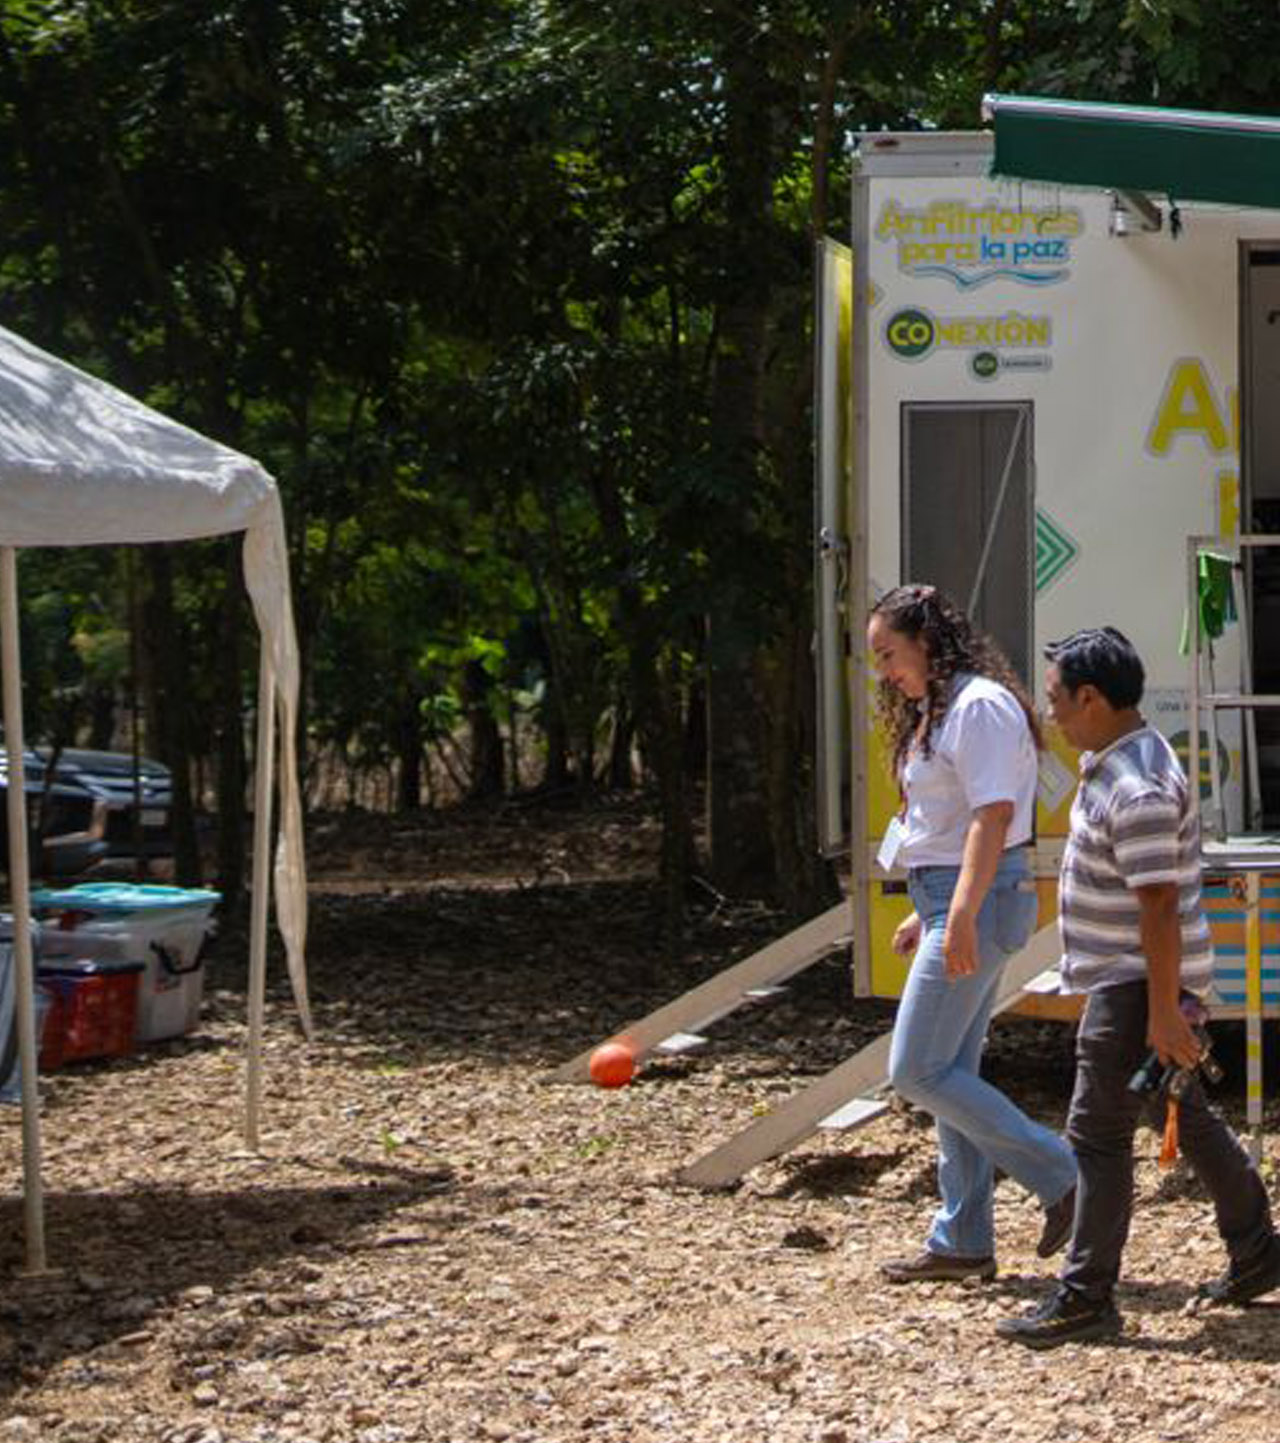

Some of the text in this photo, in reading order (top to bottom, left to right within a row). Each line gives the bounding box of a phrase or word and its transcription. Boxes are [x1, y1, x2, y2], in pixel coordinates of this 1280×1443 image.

[902, 235, 1067, 265] para la paz
